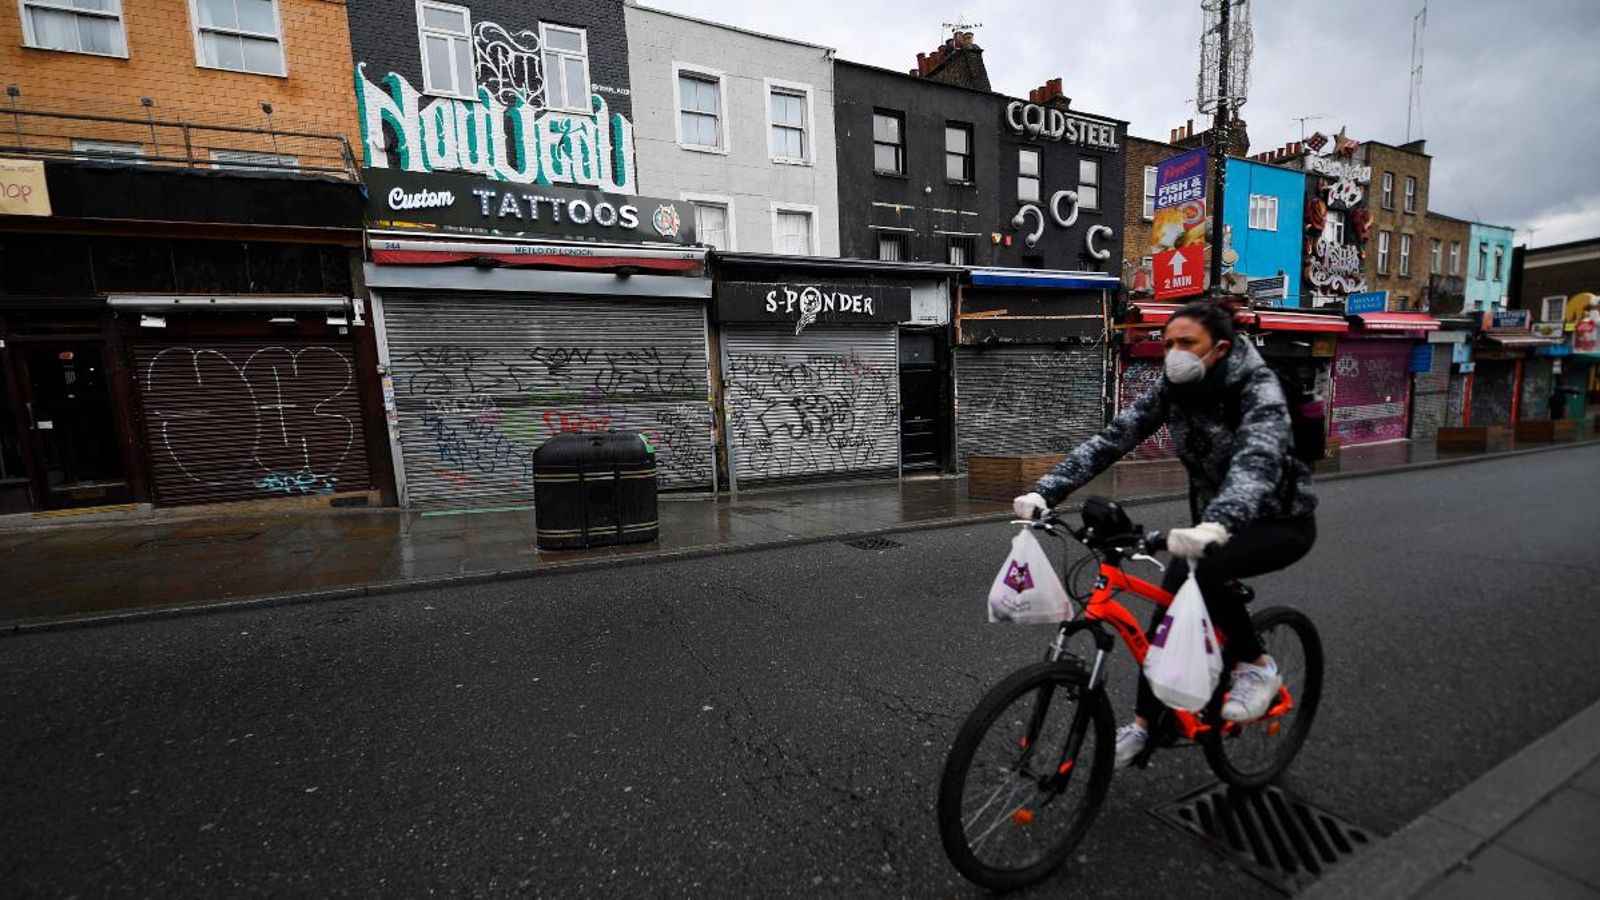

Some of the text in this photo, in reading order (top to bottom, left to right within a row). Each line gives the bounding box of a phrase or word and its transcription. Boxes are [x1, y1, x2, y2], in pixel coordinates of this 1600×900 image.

[1007, 101, 1120, 152] COLD STEEL
[1159, 175, 1202, 197] FISH &
[1158, 187, 1202, 207] CHIPS
[388, 187, 639, 229] Custom TATTOOS
[385, 242, 400, 251] 244
[545, 247, 558, 256] OF
[559, 248, 594, 257] LONDON
[1164, 276, 1192, 289] 2 MIN
